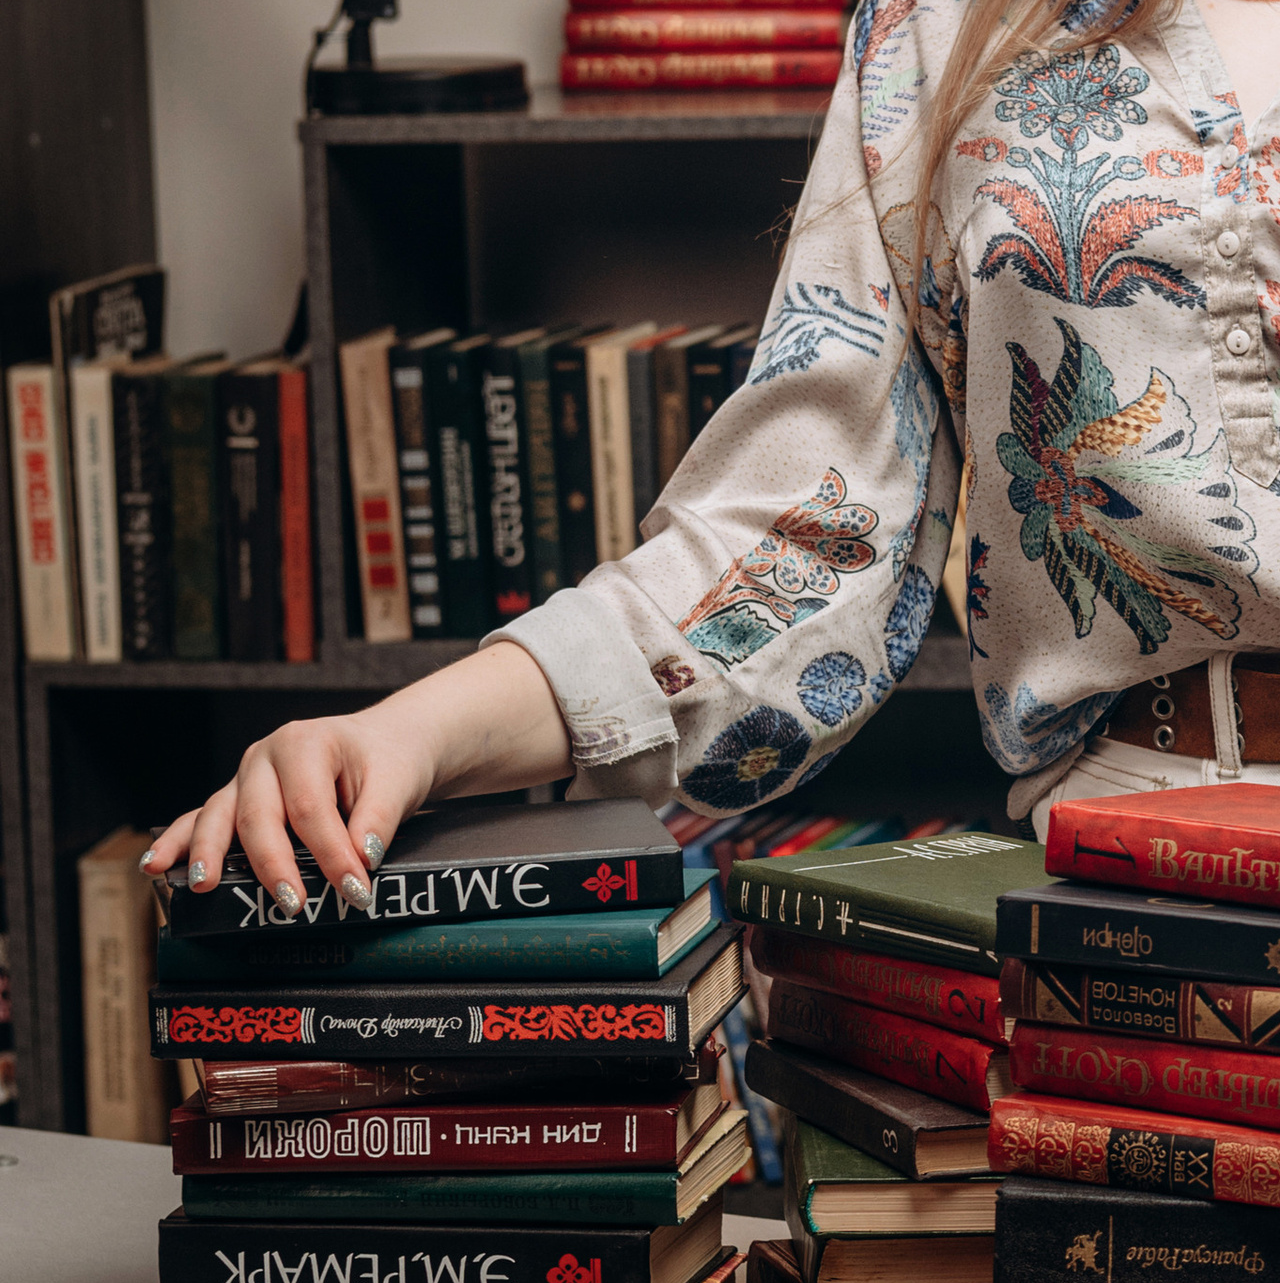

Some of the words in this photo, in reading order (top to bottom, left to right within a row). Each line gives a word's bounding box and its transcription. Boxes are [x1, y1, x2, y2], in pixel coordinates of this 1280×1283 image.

[1092, 980, 1177, 1008] КОЧЕТОВ
[1092, 1005, 1177, 1034] Всеволод
[243, 1115, 432, 1159] ШОРОХИ
[542, 1121, 602, 1145] ДИН
